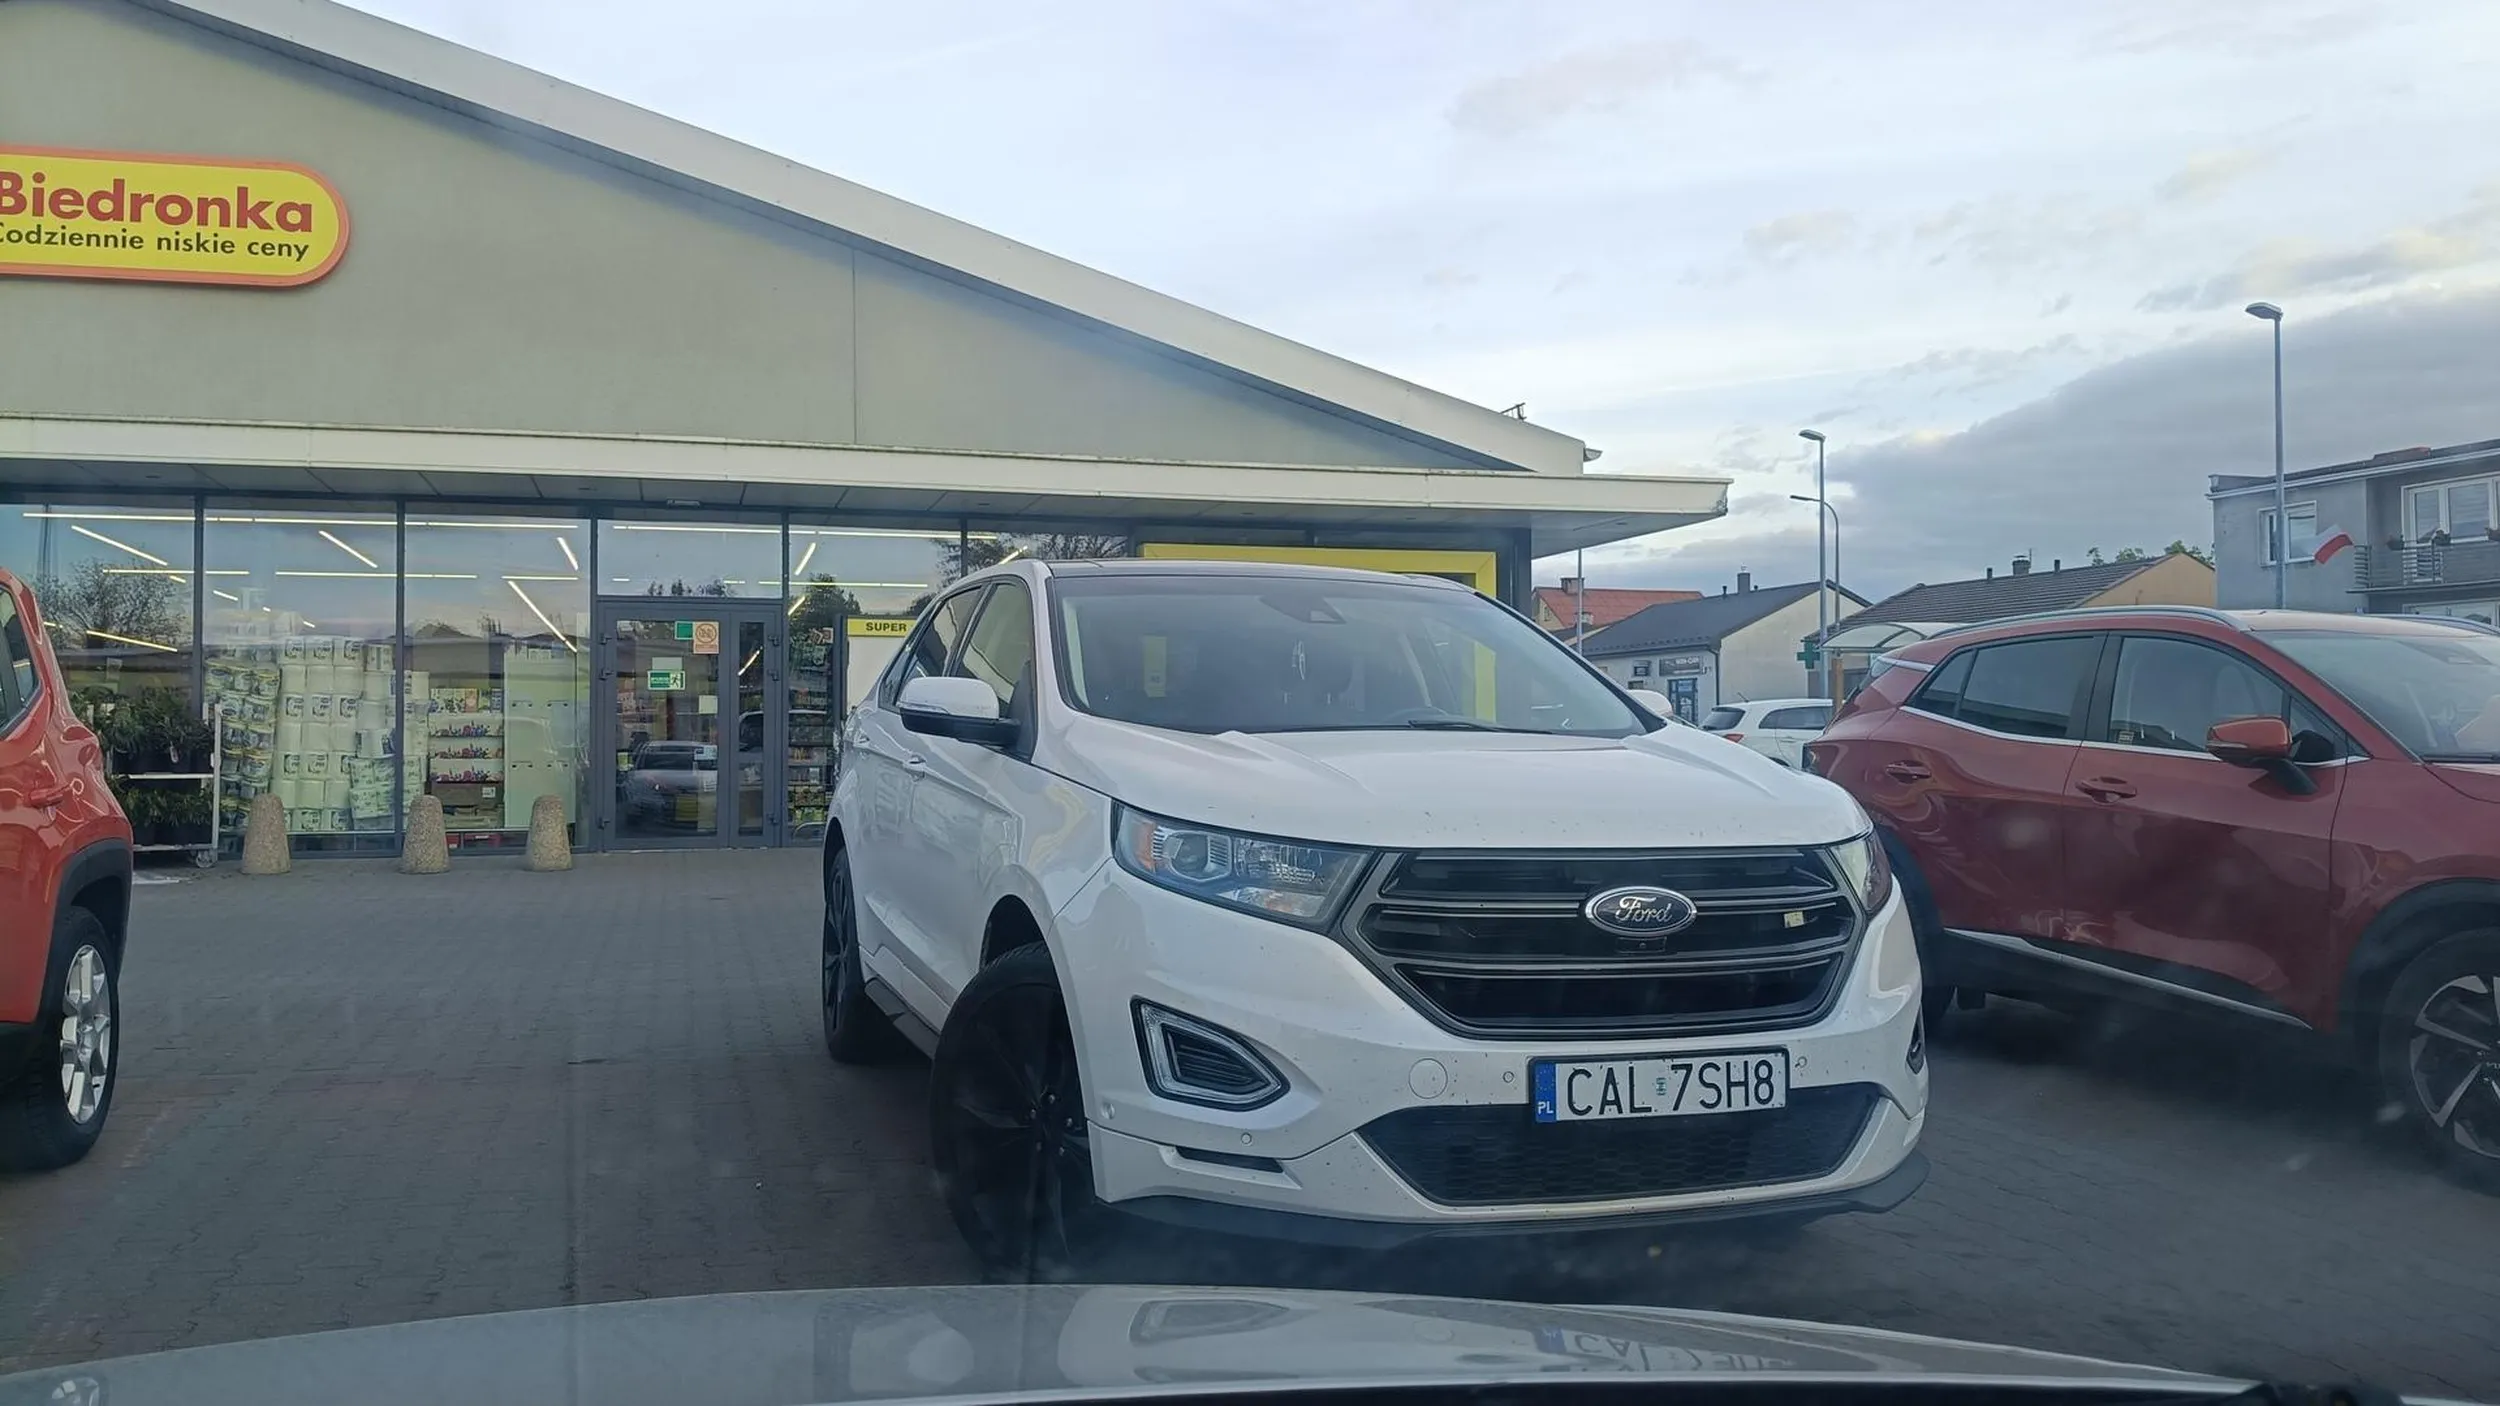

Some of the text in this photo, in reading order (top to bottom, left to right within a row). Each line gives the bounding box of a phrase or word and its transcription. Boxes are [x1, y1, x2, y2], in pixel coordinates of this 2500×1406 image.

[0, 171, 313, 232] Biedronka
[0, 222, 309, 261] odziennie niskie ceny
[866, 622, 907, 632] SUPER
[1615, 896, 1673, 923] Ford
[1567, 1060, 1775, 1116] CAL 7SH8
[1537, 1101, 1554, 1115] PL
